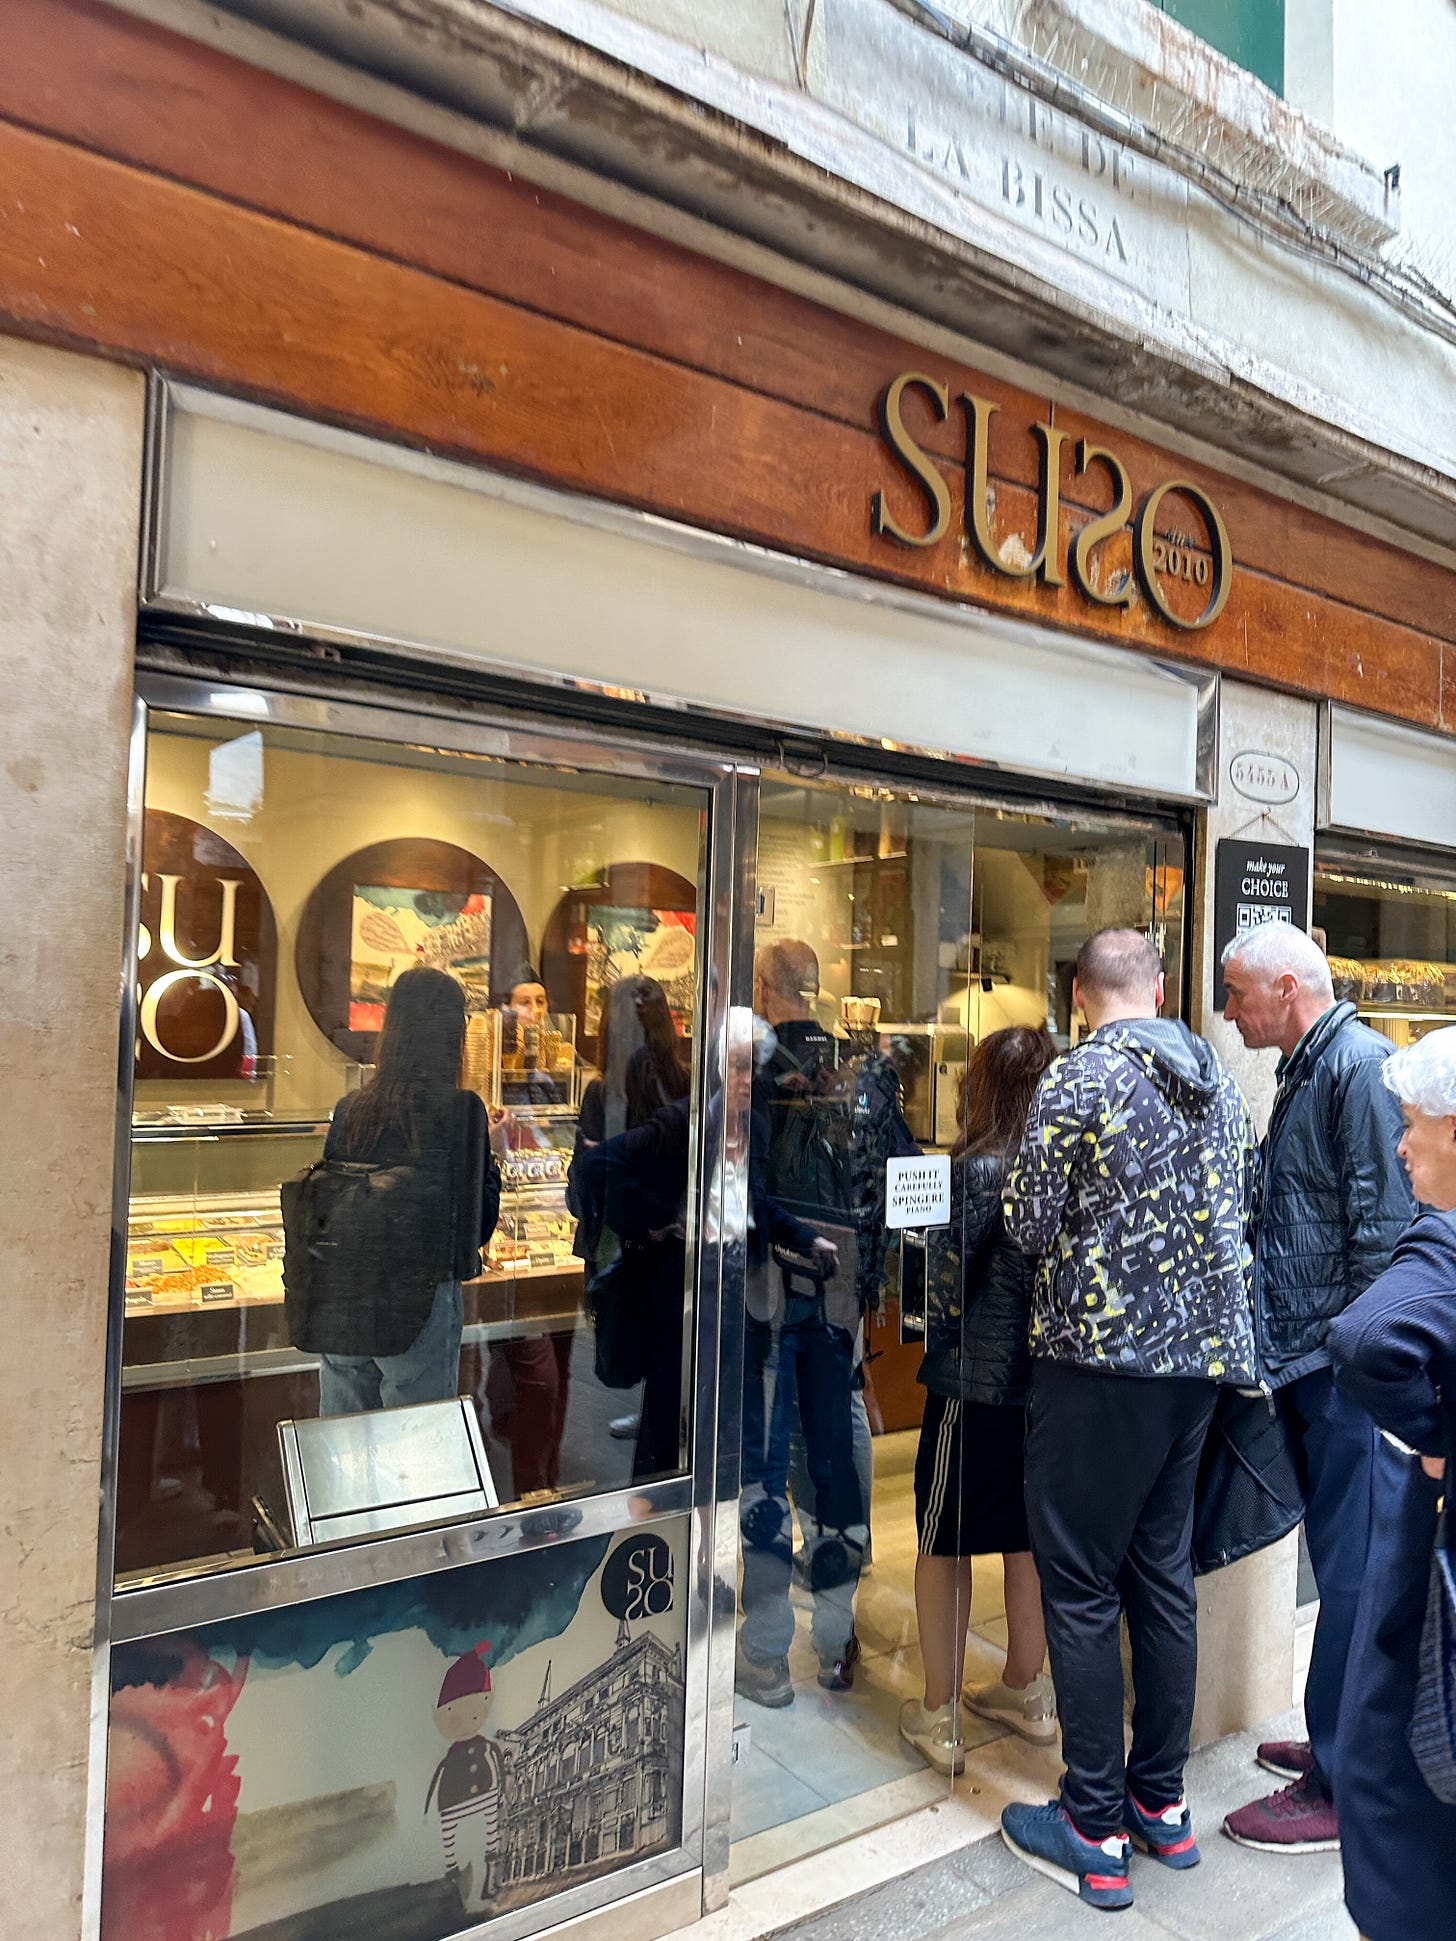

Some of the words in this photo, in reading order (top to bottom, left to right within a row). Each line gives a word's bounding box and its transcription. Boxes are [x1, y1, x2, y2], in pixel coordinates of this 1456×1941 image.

[1080, 131, 1136, 199] DE
[906, 105, 972, 181] LA
[1000, 155, 1128, 265] BISSA
[871, 371, 1233, 630] SUSO
[1154, 543, 1209, 586] 2010
[1246, 856, 1267, 873] make
[1266, 862, 1286, 878] your
[1241, 877, 1289, 898] CHOICE
[136, 968, 239, 1063] O
[898, 1169, 926, 1182] PUSH
[928, 1168, 940, 1180] IT
[894, 1180, 943, 1193] CAREFULLY
[892, 1192, 945, 1208] SPINGERE
[906, 1205, 932, 1215] PIANO
